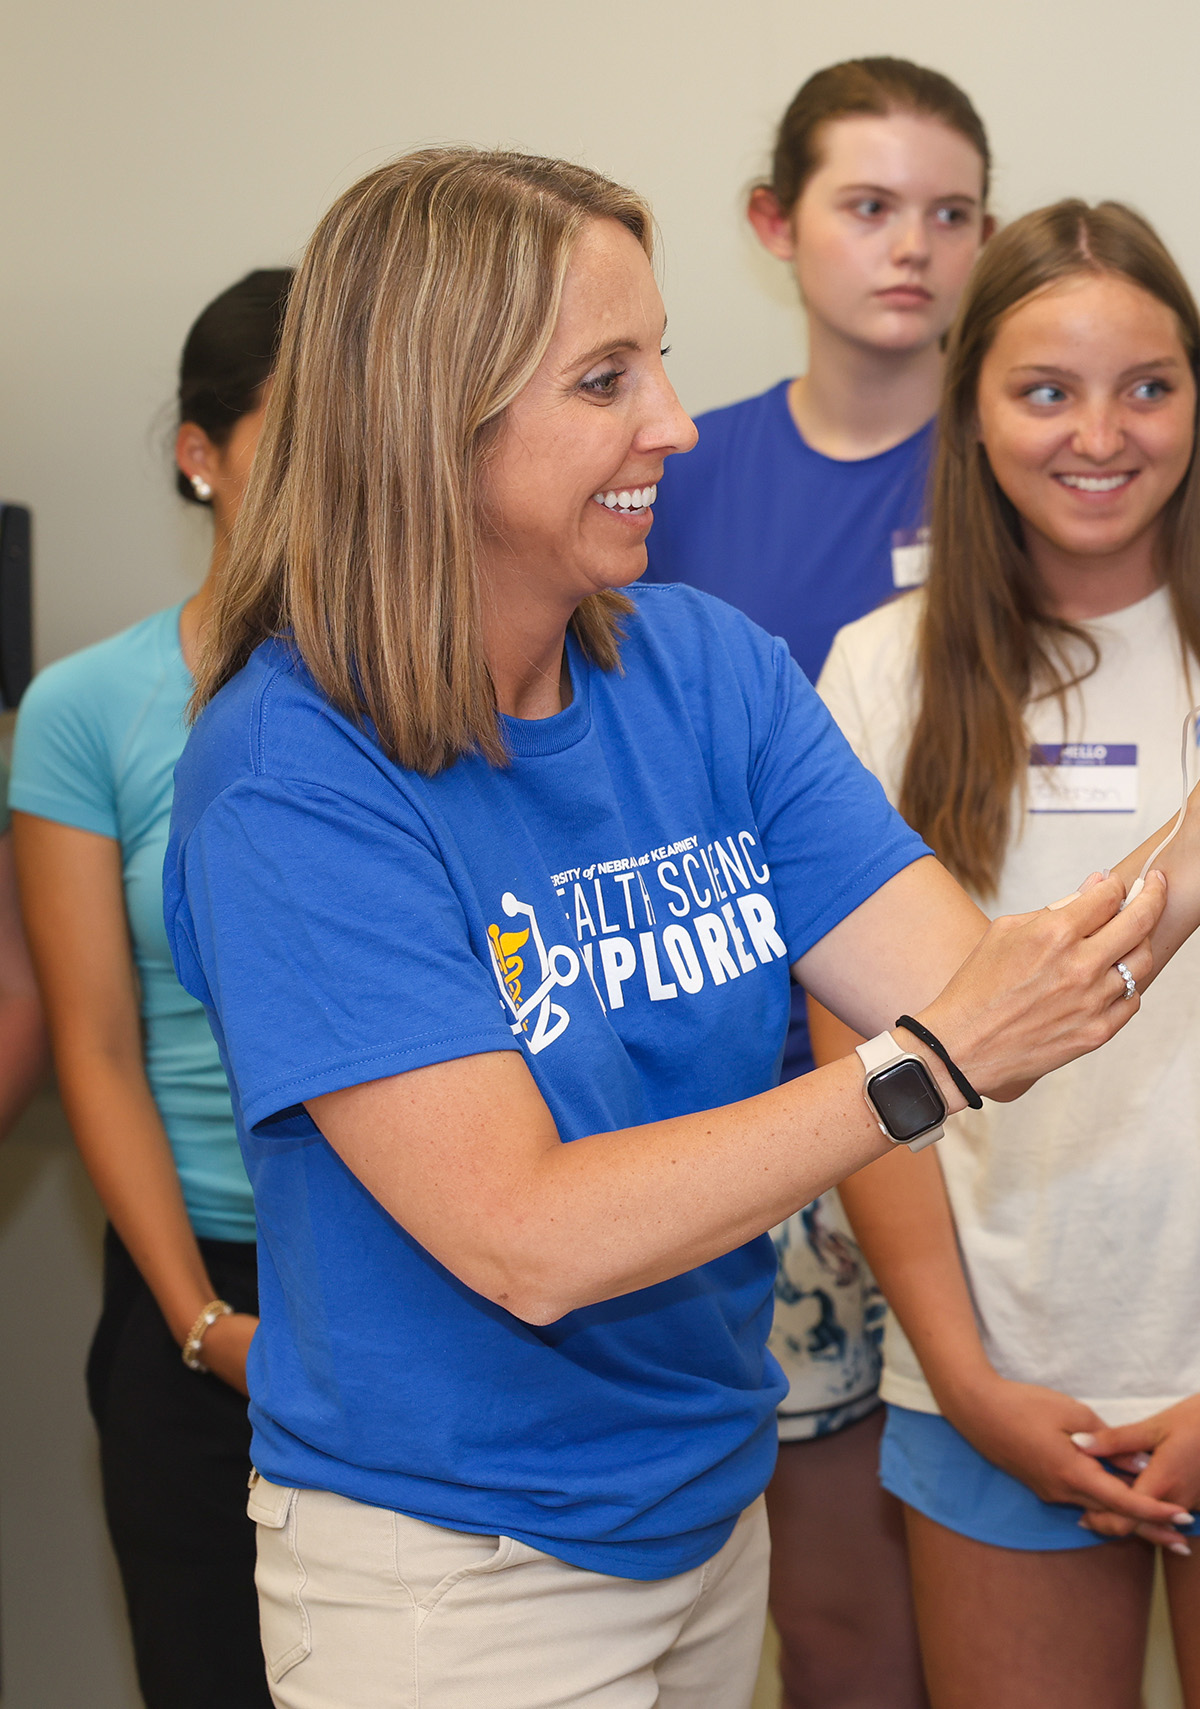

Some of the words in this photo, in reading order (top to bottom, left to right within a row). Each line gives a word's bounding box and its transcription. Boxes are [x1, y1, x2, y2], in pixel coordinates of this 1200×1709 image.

[582, 864, 597, 880] of
[638, 853, 651, 866] at
[650, 835, 699, 861] KEARNEY
